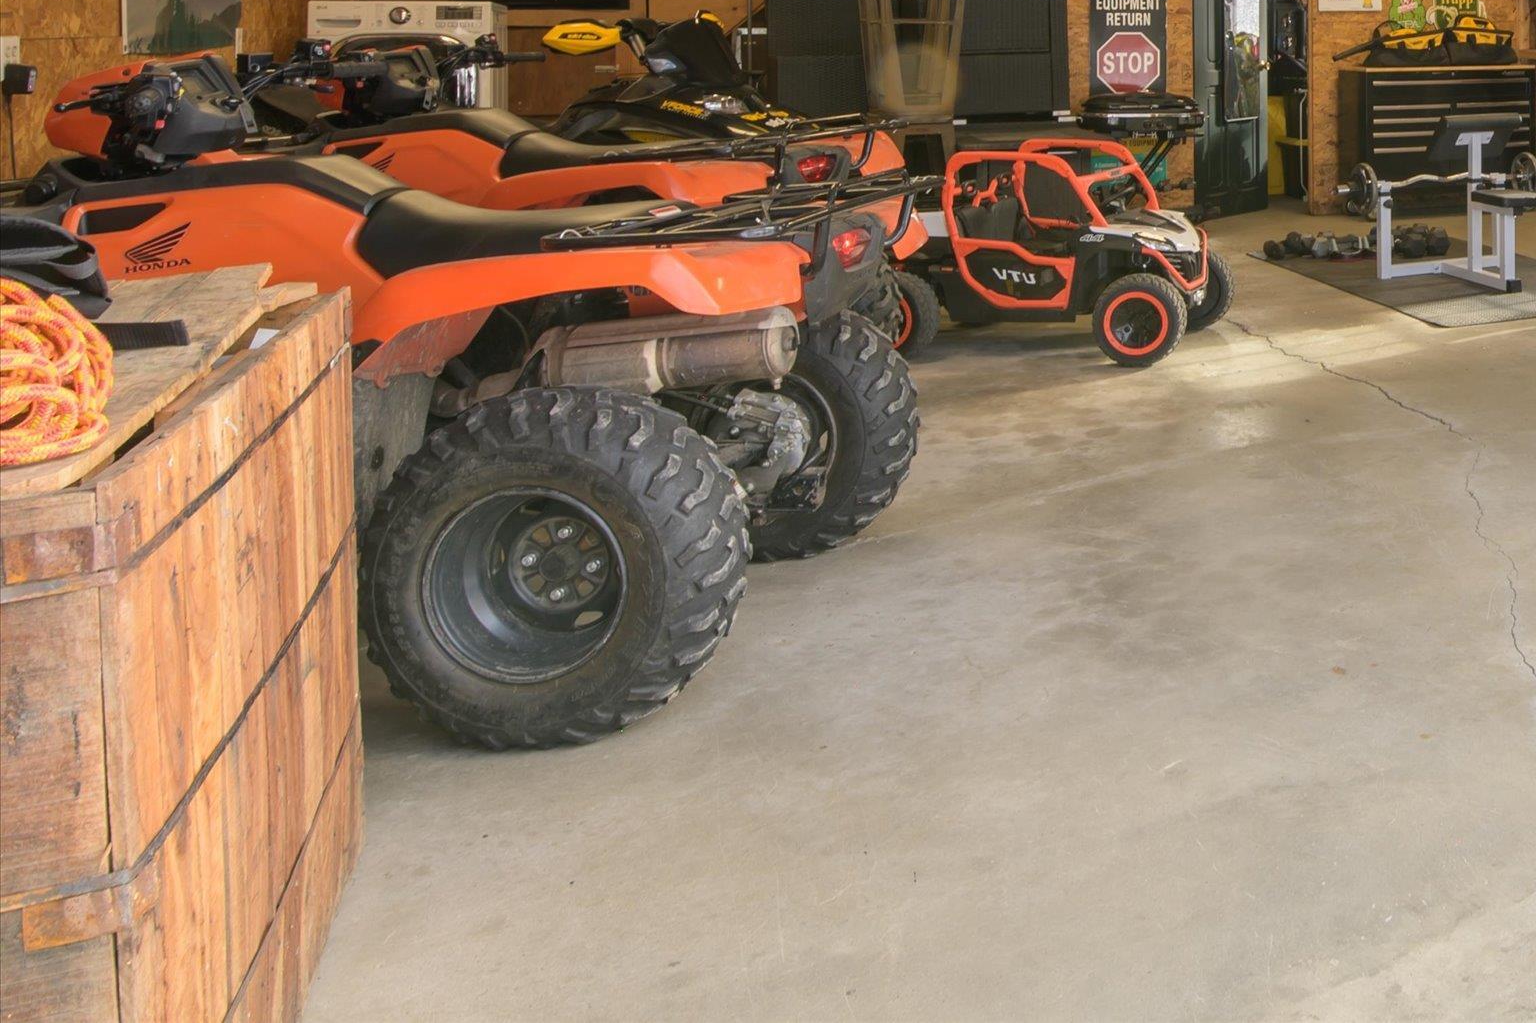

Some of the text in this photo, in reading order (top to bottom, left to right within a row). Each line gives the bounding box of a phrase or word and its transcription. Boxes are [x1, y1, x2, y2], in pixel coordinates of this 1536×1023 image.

[1105, 12, 1152, 27] RETURN
[1102, 51, 1155, 75] STOP
[125, 258, 192, 274] HONDA
